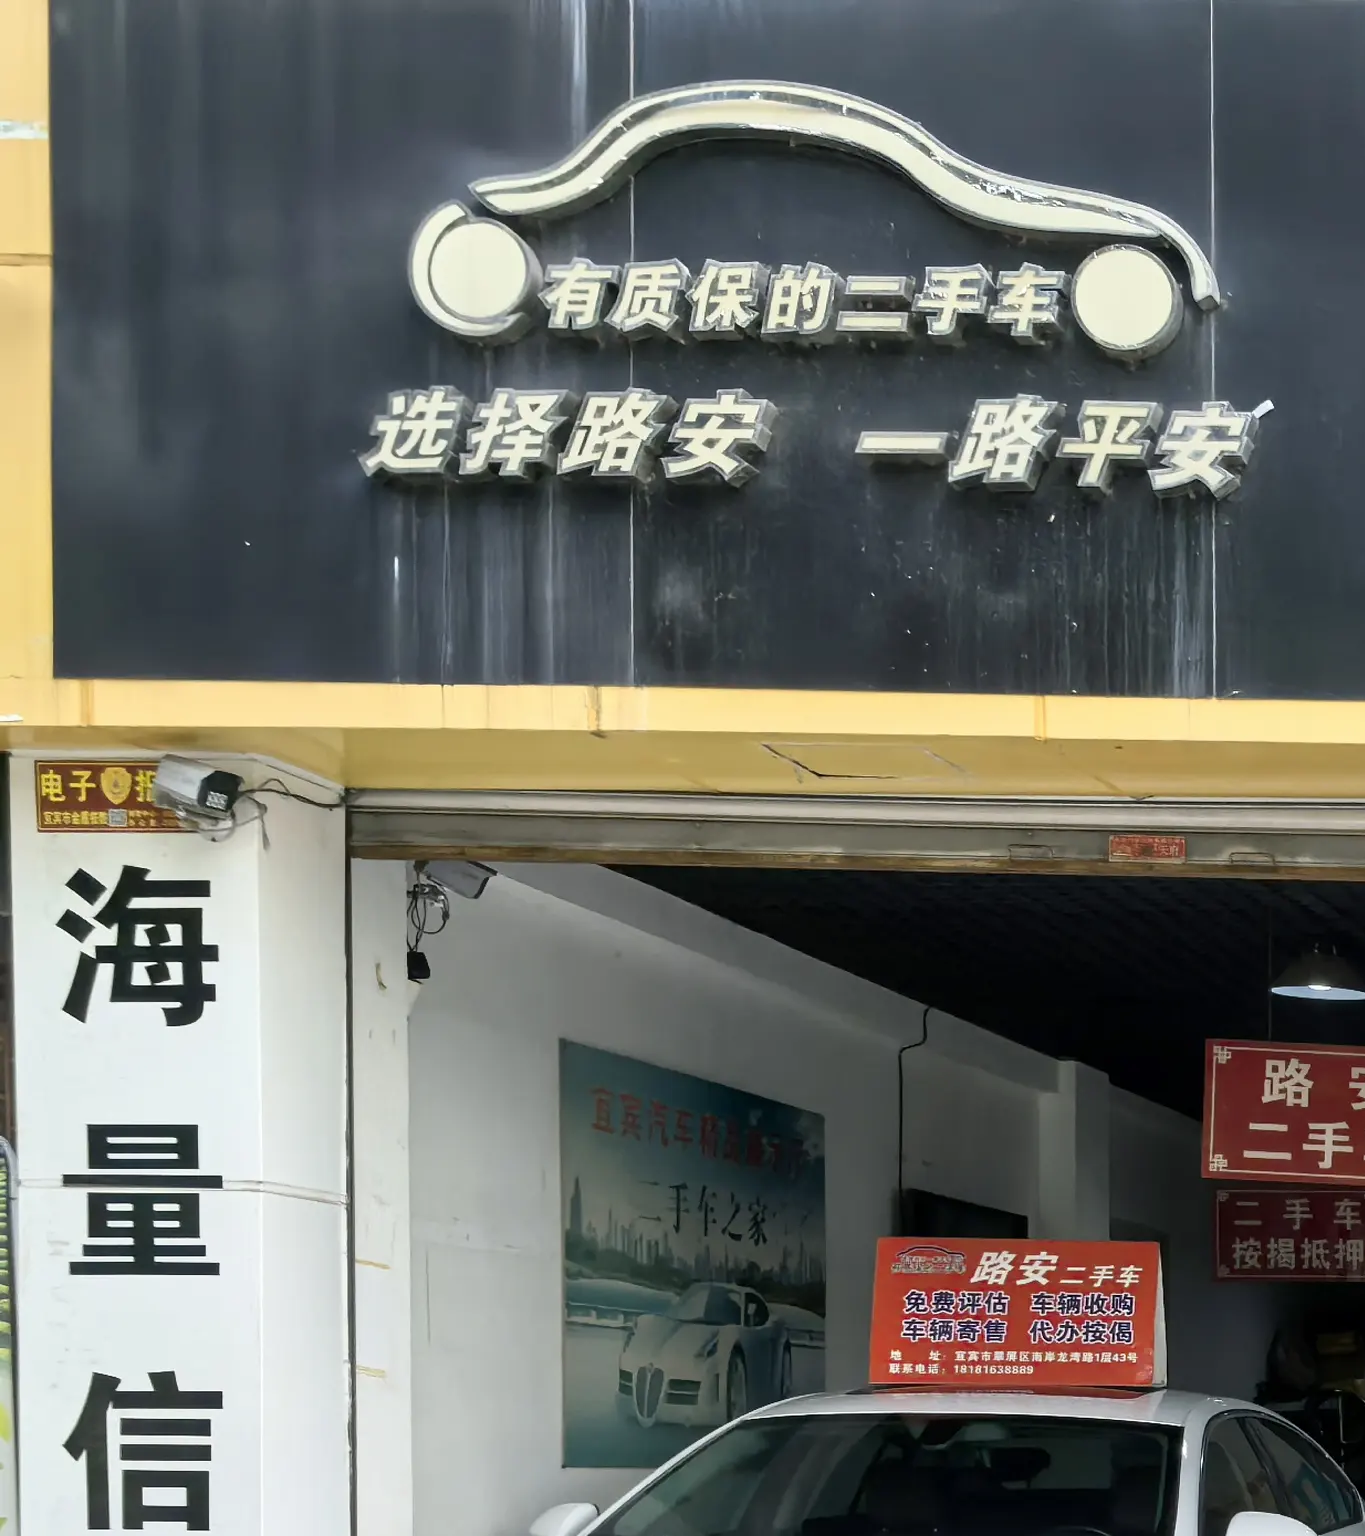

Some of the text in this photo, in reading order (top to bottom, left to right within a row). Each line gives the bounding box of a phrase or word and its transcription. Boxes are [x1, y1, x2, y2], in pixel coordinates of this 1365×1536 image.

[542, 259, 1070, 344] 有质保的二手车
[362, 387, 1258, 498] 选择路安 一路平安
[1233, 1198, 1362, 1231] 二手车
[1232, 1237, 1365, 1271] 按揭抵押
[903, 1290, 1135, 1317] 免费评估 车辆收购
[901, 1319, 1007, 1344] 车辆寄售
